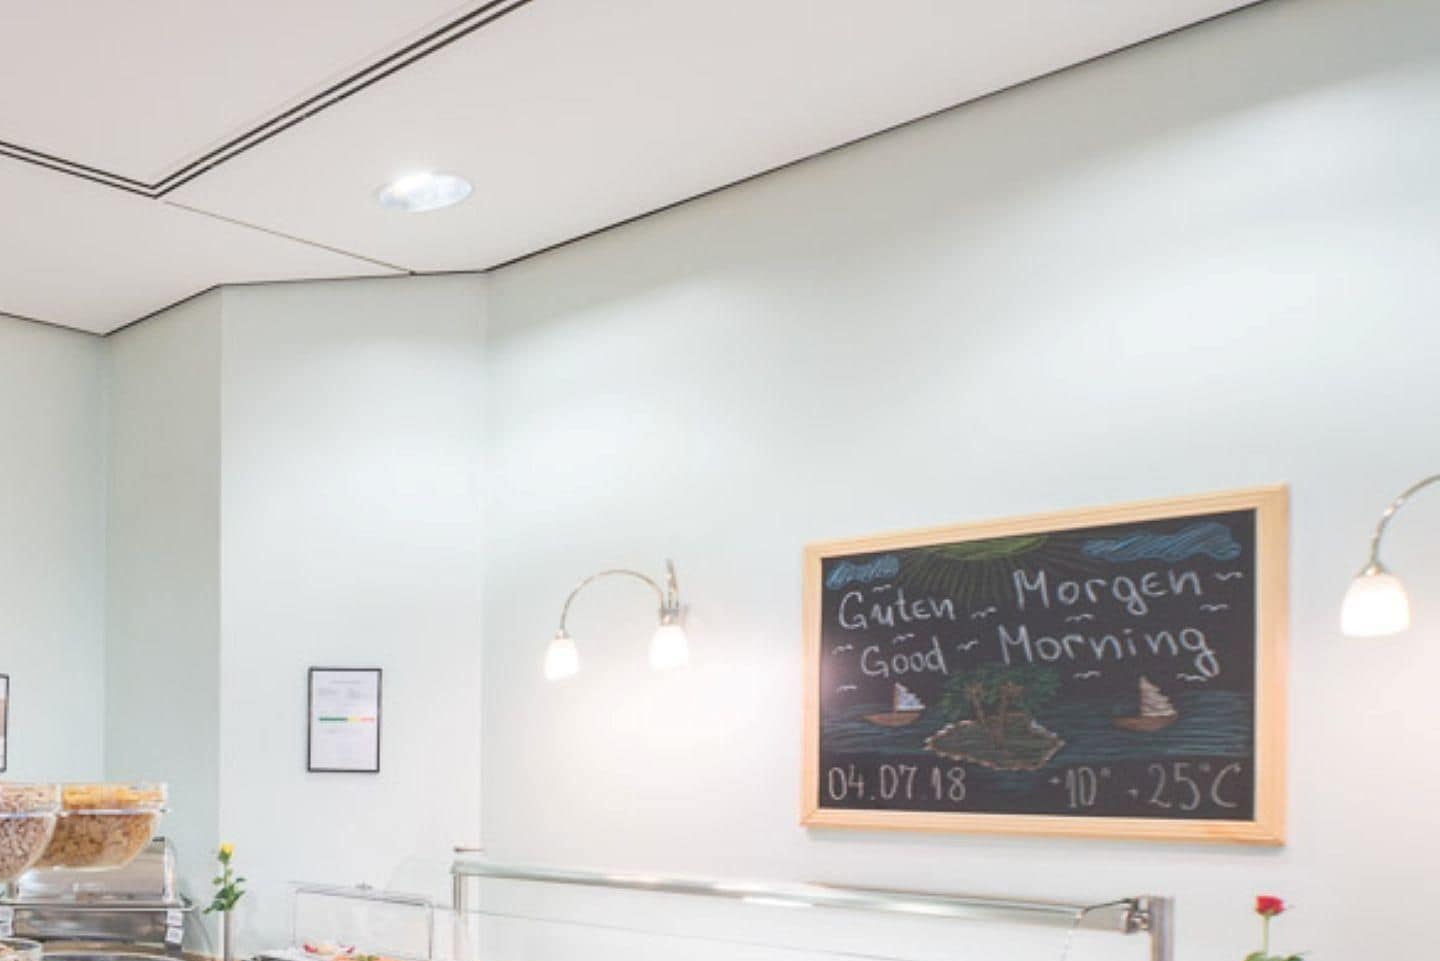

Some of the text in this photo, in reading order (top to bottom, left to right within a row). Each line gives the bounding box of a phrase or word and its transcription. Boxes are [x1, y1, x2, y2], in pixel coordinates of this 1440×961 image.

[838, 569, 1203, 630] Guten Morgen
[861, 624, 1220, 677] Good Morning
